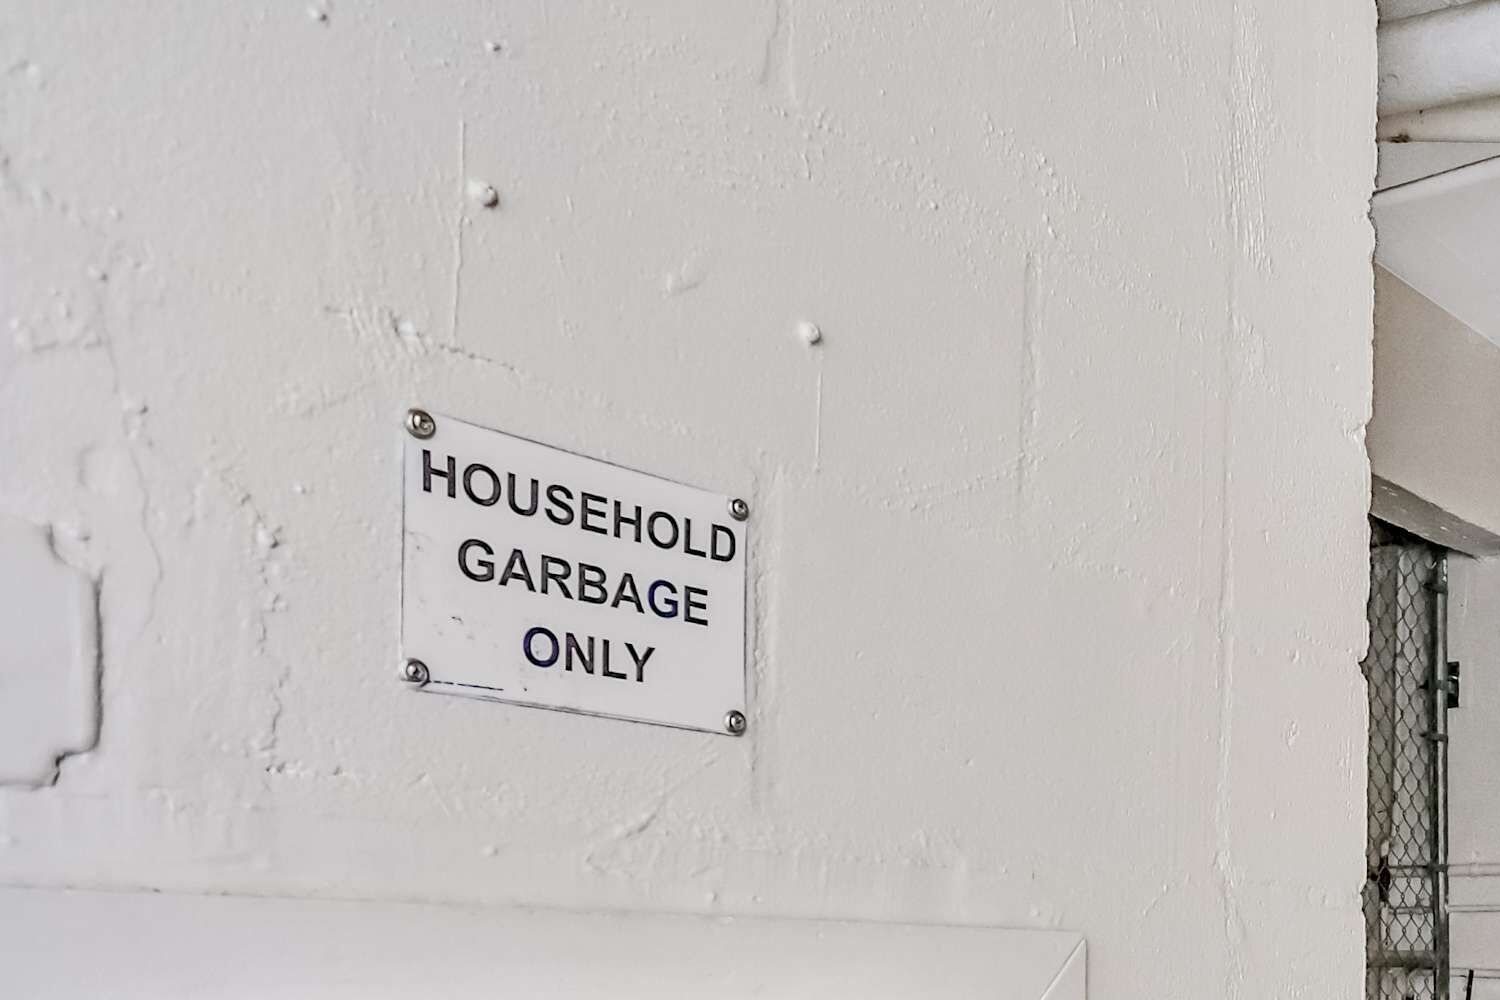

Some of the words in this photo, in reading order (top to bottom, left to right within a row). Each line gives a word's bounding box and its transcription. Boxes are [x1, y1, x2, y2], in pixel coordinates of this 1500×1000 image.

[421, 448, 737, 563] HOUSEHOLD
[457, 538, 709, 627] GARBAGE
[522, 626, 656, 683] ONLY
